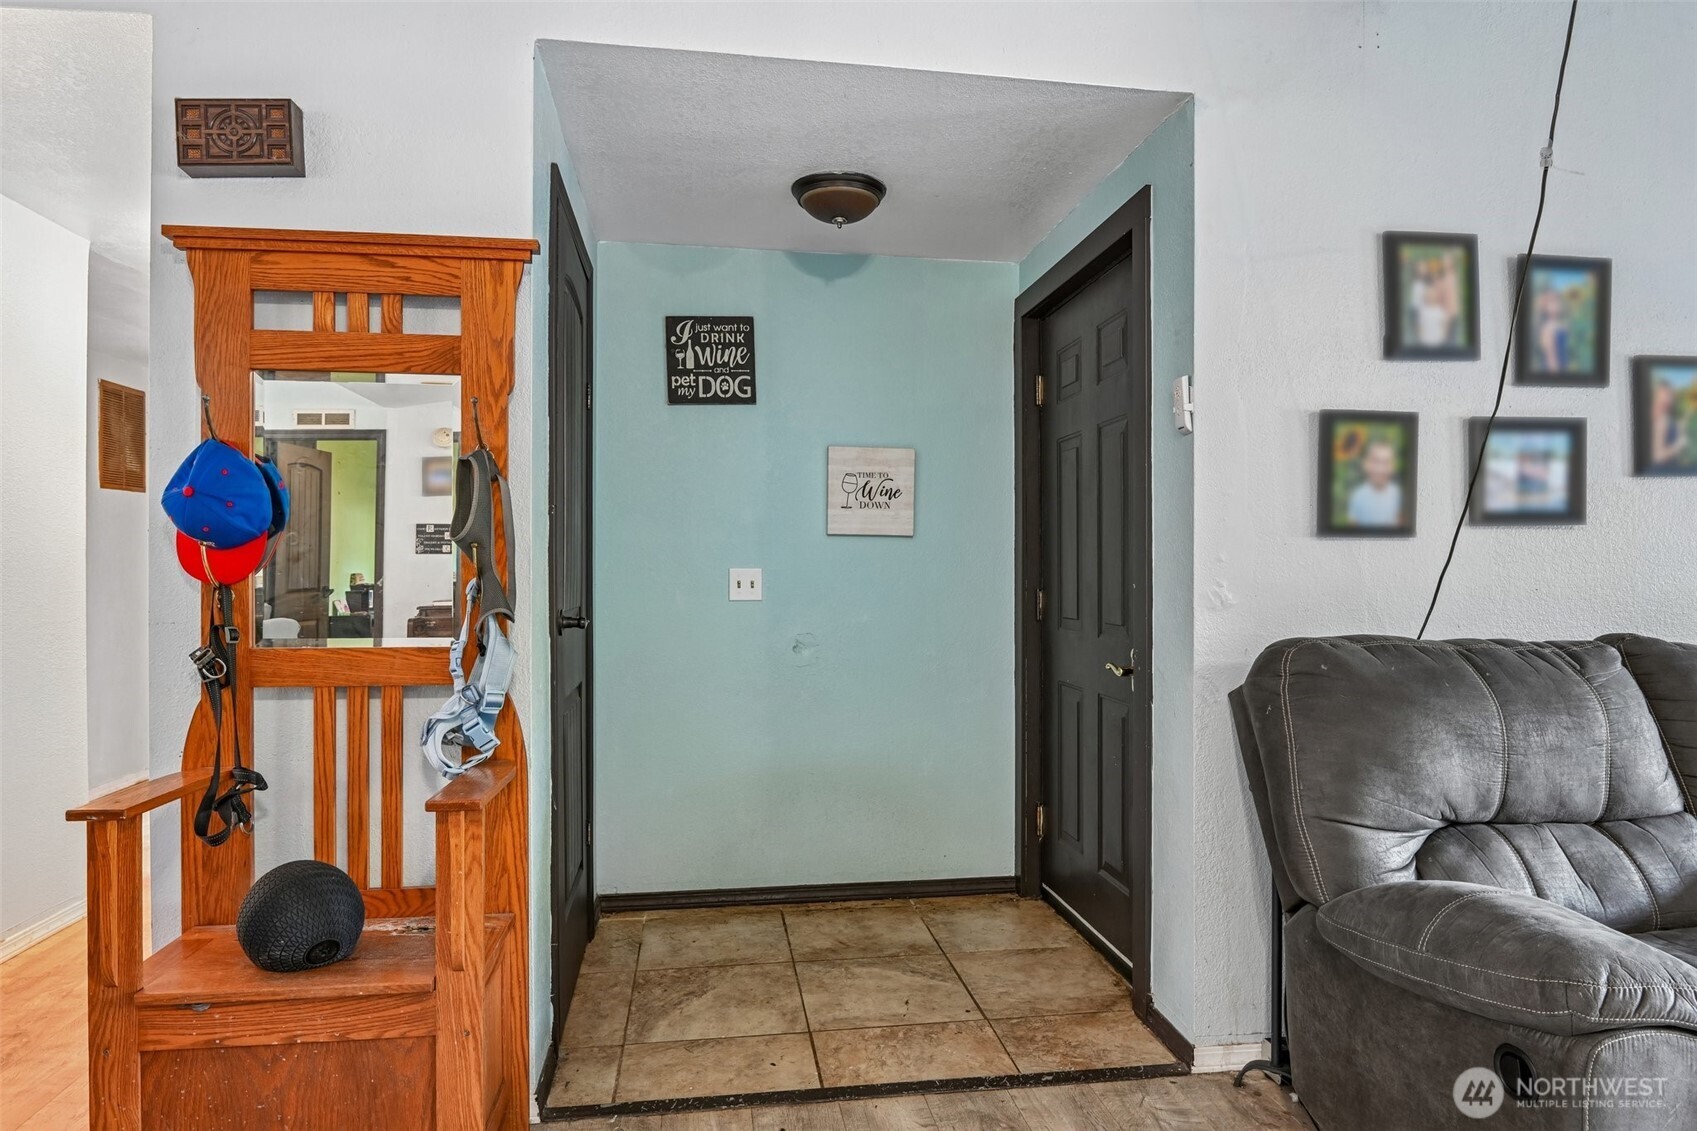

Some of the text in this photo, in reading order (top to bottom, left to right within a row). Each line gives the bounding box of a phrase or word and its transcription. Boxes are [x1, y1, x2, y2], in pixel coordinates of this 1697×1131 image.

[695, 323, 711, 333] just
[713, 324, 737, 332] want
[740, 323, 750, 332] to
[700, 332, 745, 343] DRINK
[694, 343, 750, 368] Wine
[713, 366, 730, 374] and
[671, 373, 752, 398] pet DOG
[677, 386, 696, 399] my
[857, 471, 890, 479] TIME TO
[855, 478, 903, 501] Wine
[859, 501, 891, 510] DOWN
